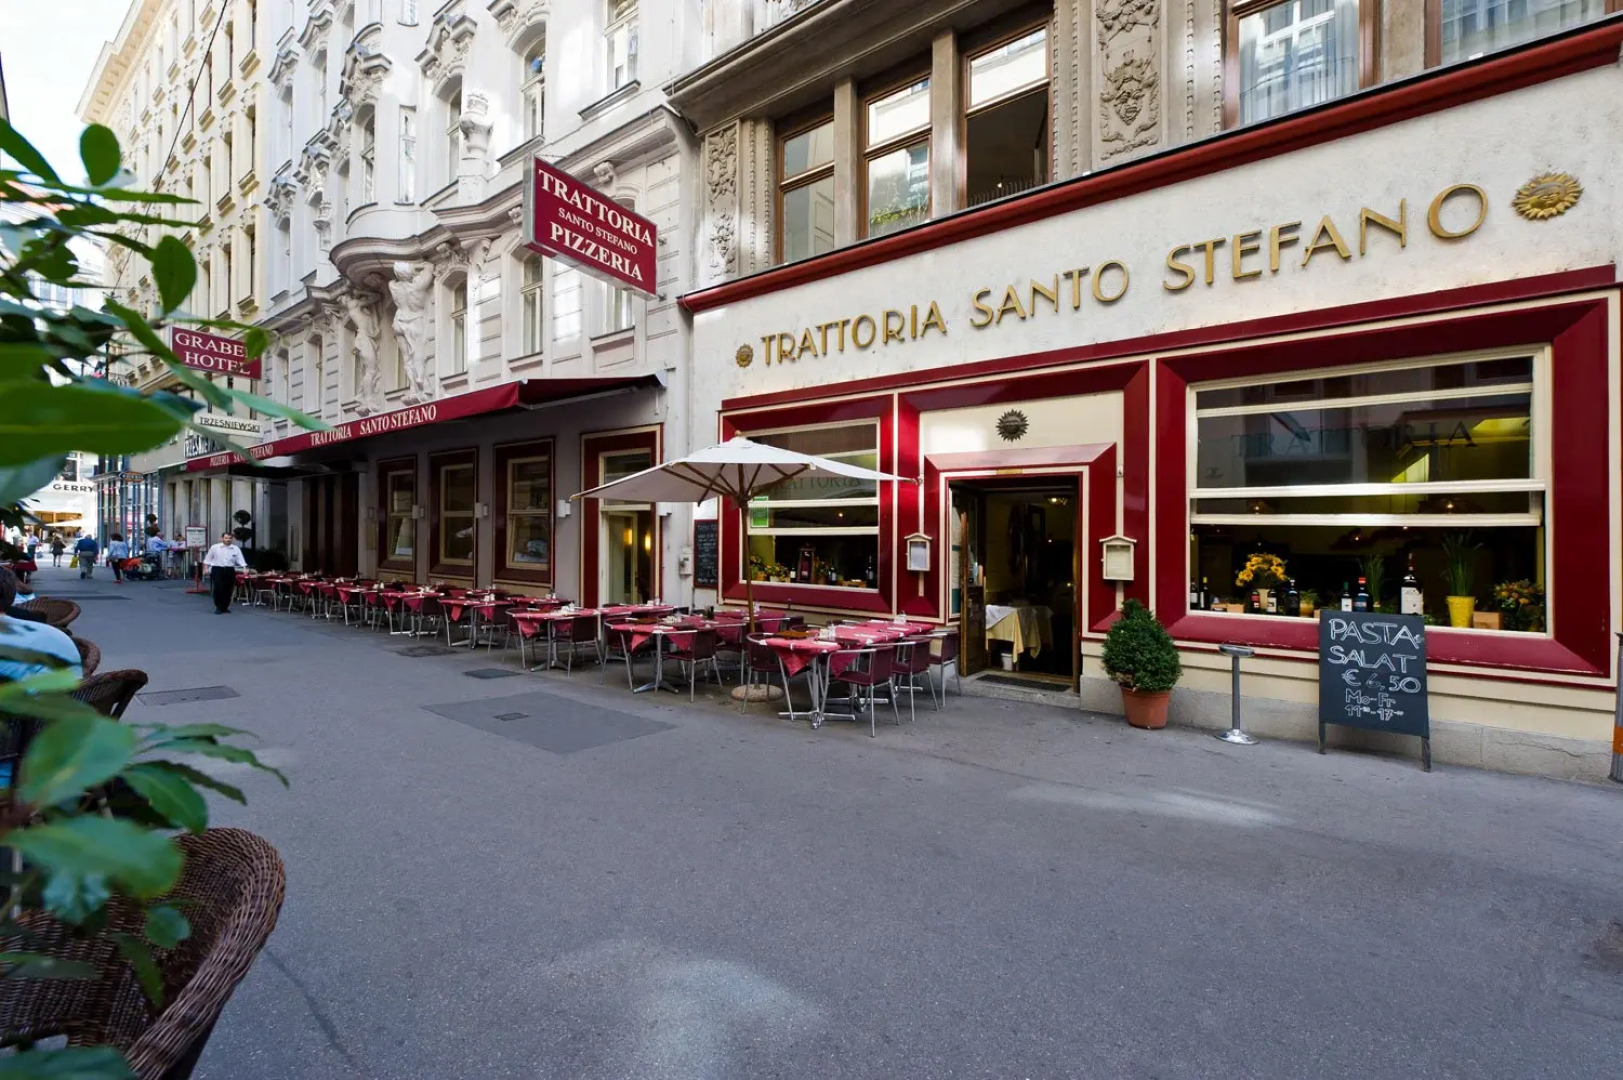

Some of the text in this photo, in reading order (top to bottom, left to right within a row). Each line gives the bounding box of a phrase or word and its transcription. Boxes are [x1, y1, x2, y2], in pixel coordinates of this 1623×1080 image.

[538, 169, 654, 247] TRATTORIA
[558, 207, 638, 255] SANTO STEFANO
[550, 221, 643, 282] PIZZERIA
[761, 183, 1489, 365] TRATTORIA SANTO STEFANO
[175, 332, 249, 358] GRABE
[184, 351, 251, 375] HOTEL
[310, 405, 437, 446] TRATTORIA SANTO STEFANO
[53, 483, 95, 492] GERRY
[1329, 618, 1419, 649] PASTA
[1328, 645, 1417, 673] SALAT
